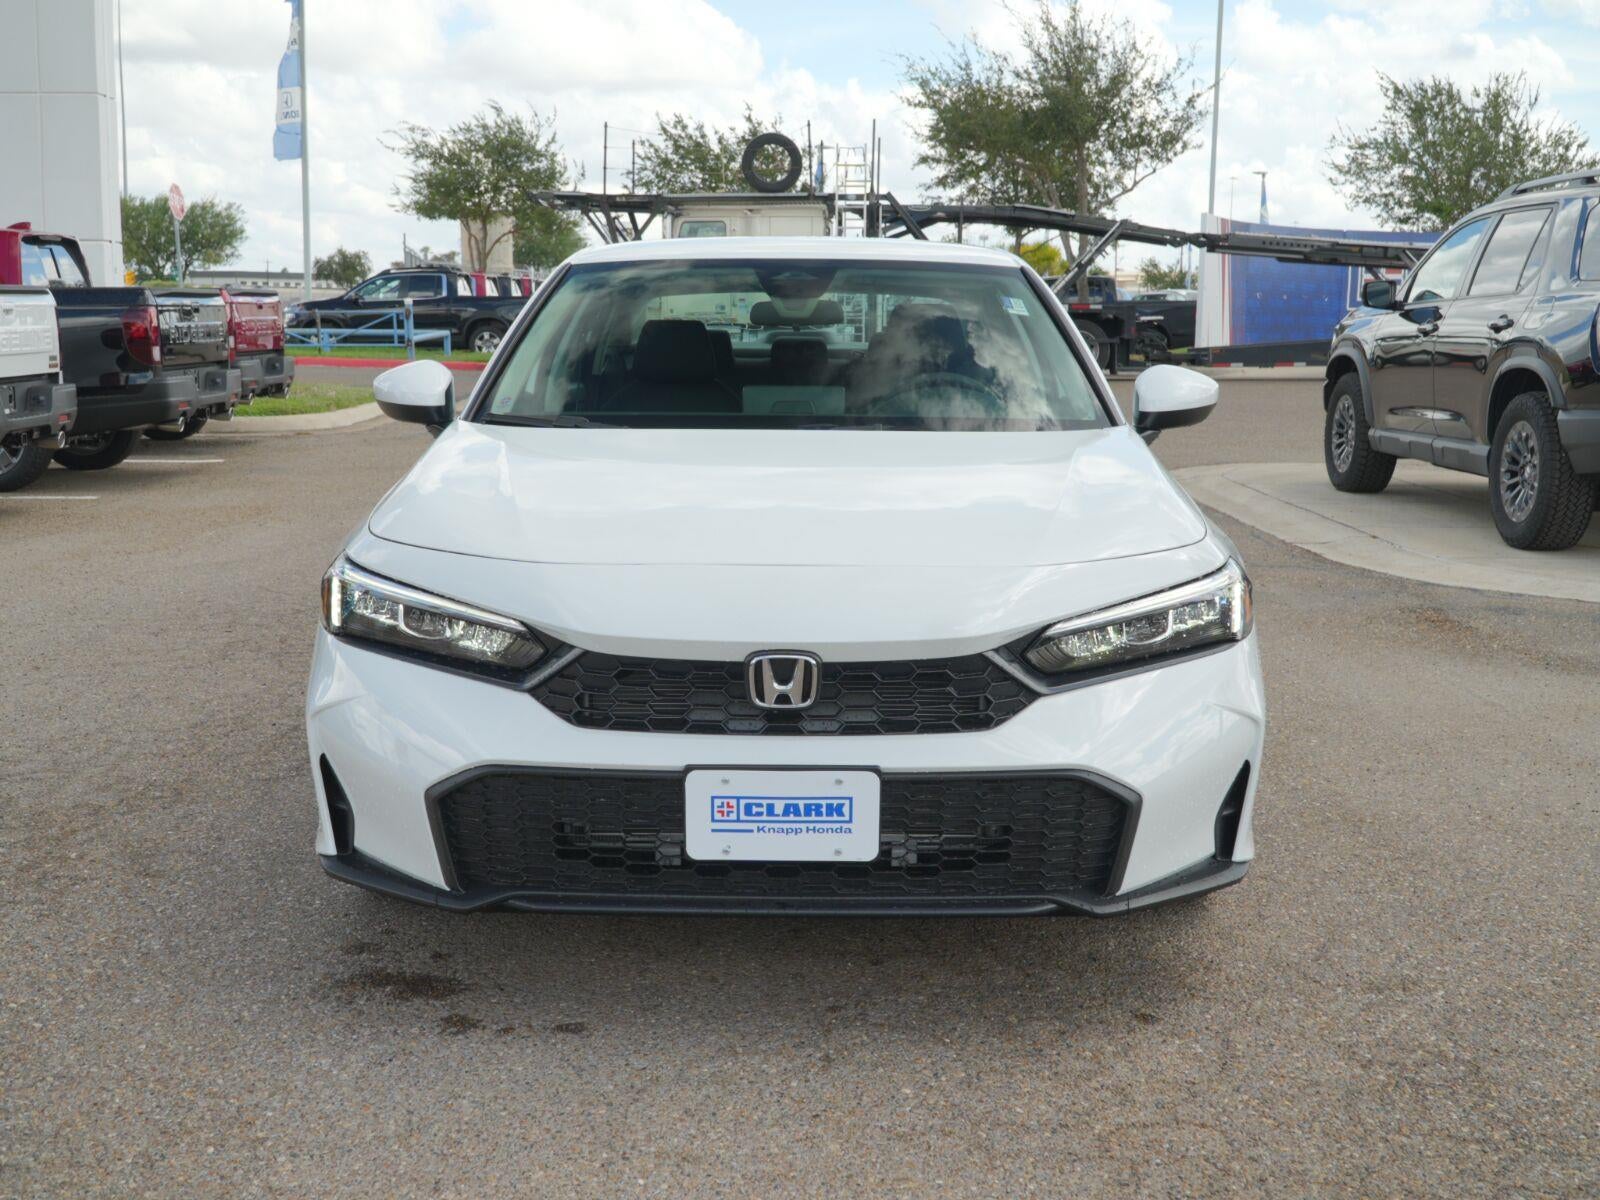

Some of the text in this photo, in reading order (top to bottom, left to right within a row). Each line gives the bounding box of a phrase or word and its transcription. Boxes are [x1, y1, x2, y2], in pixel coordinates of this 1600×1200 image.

[743, 802, 846, 818] CLARK
[756, 825, 853, 836] Knapp Honda
